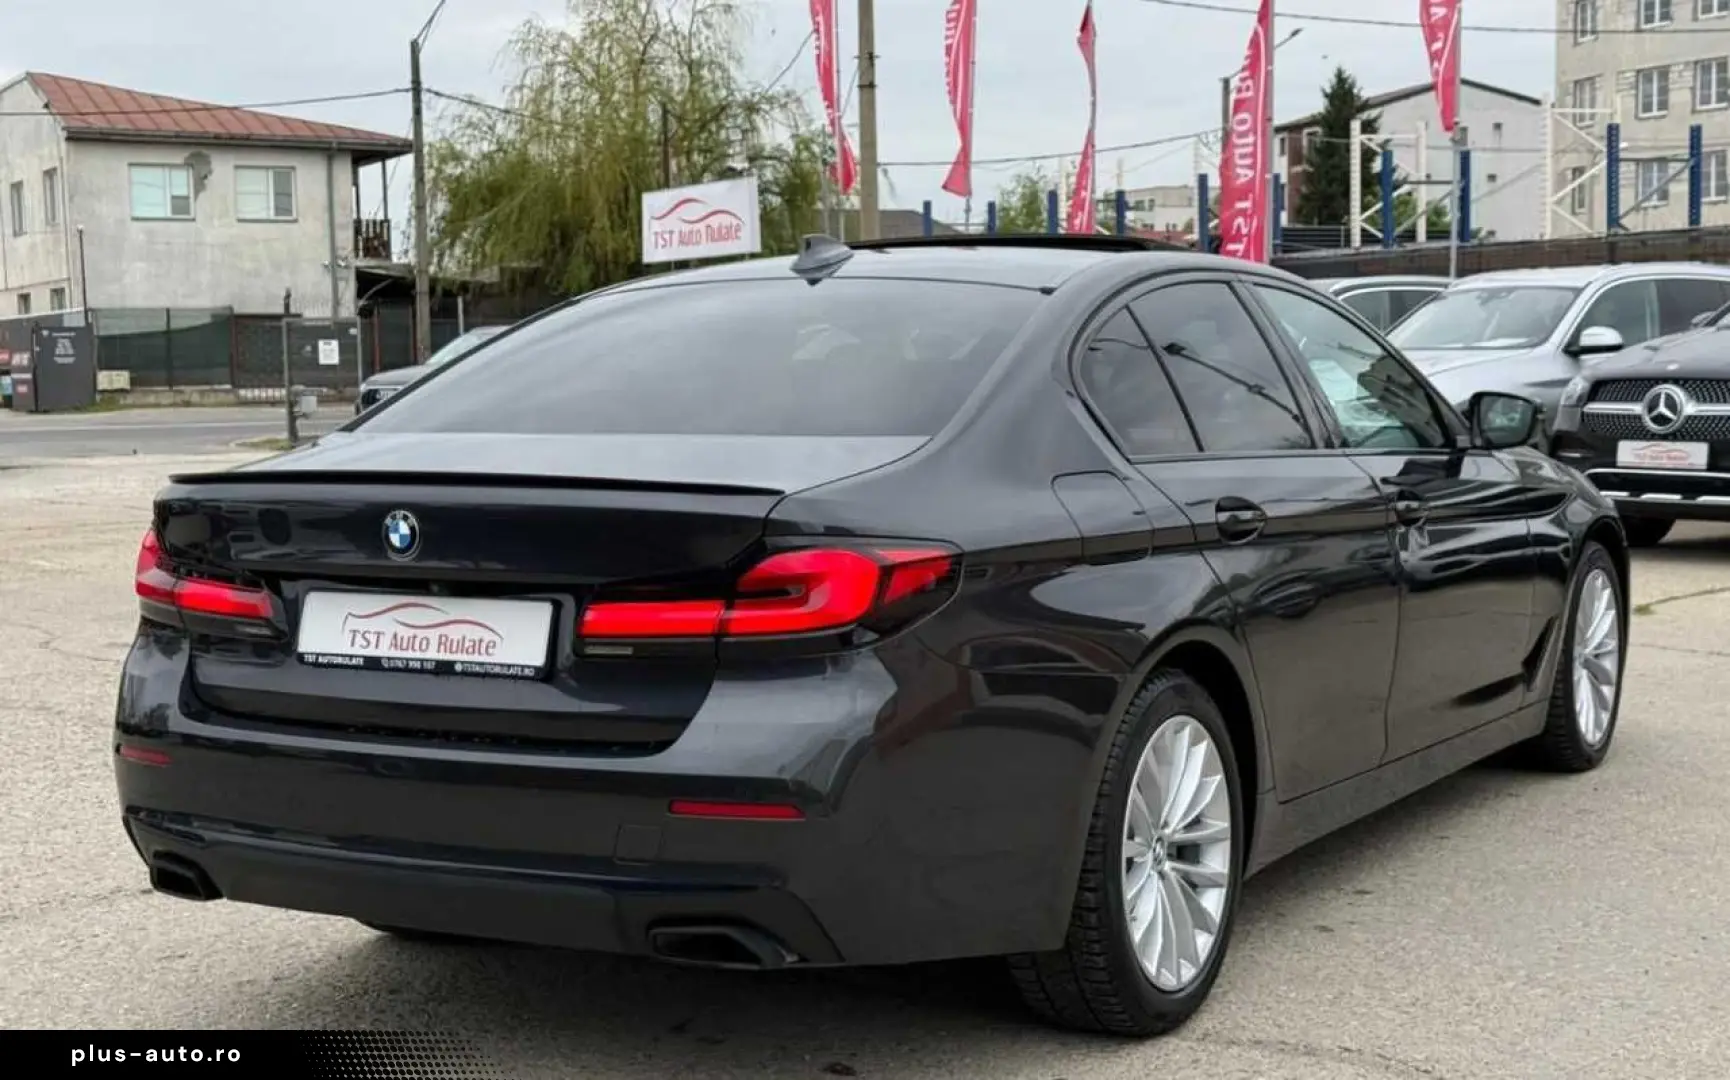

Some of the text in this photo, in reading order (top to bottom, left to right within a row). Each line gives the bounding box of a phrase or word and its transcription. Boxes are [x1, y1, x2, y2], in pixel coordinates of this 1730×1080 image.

[653, 231, 675, 249] TST
[678, 226, 702, 247] Auto
[349, 629, 497, 657] TST Auto Rulate
